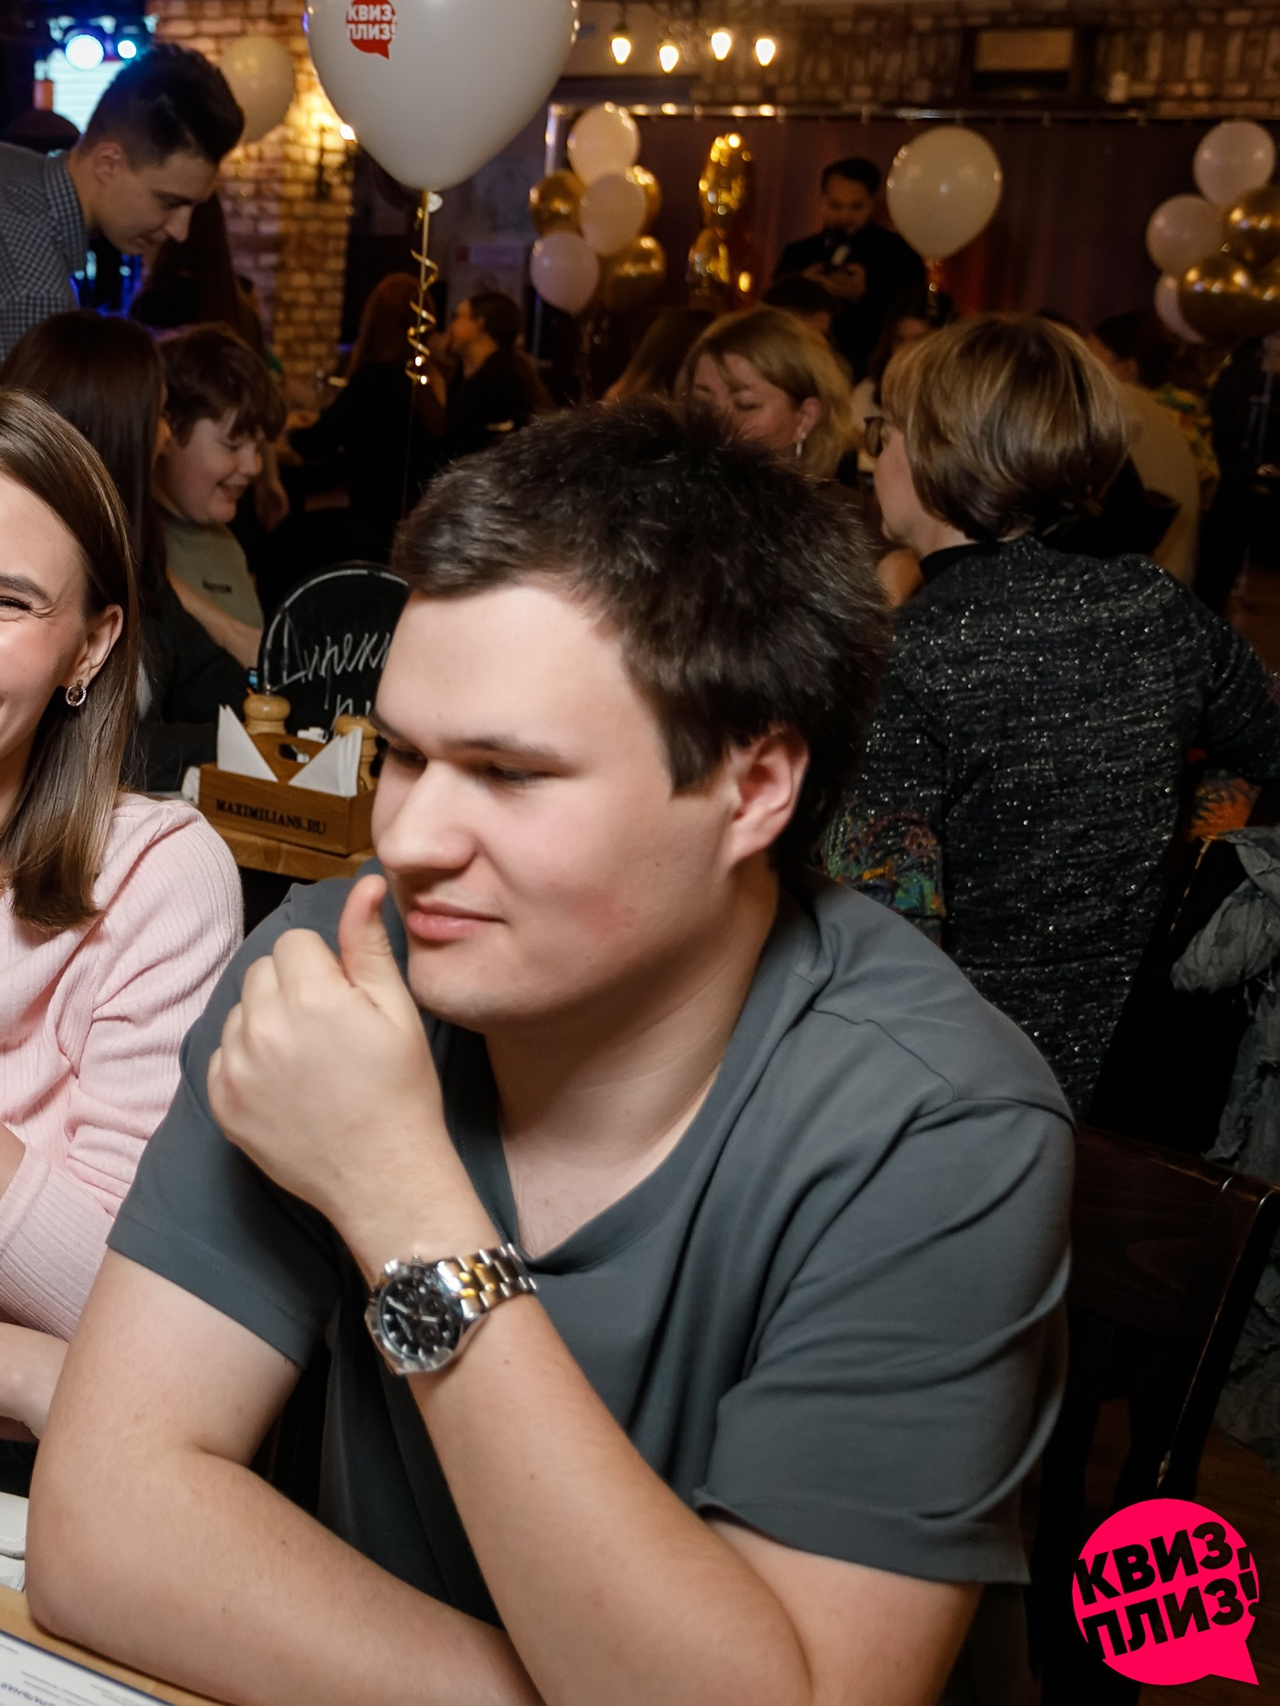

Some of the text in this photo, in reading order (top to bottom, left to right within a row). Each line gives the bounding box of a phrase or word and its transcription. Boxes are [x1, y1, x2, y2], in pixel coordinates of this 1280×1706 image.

[347, 4, 398, 24] КВИЗ,
[347, 23, 397, 40] ПЛИЗ!
[216, 798, 328, 835] MAXIMILIANS.RU
